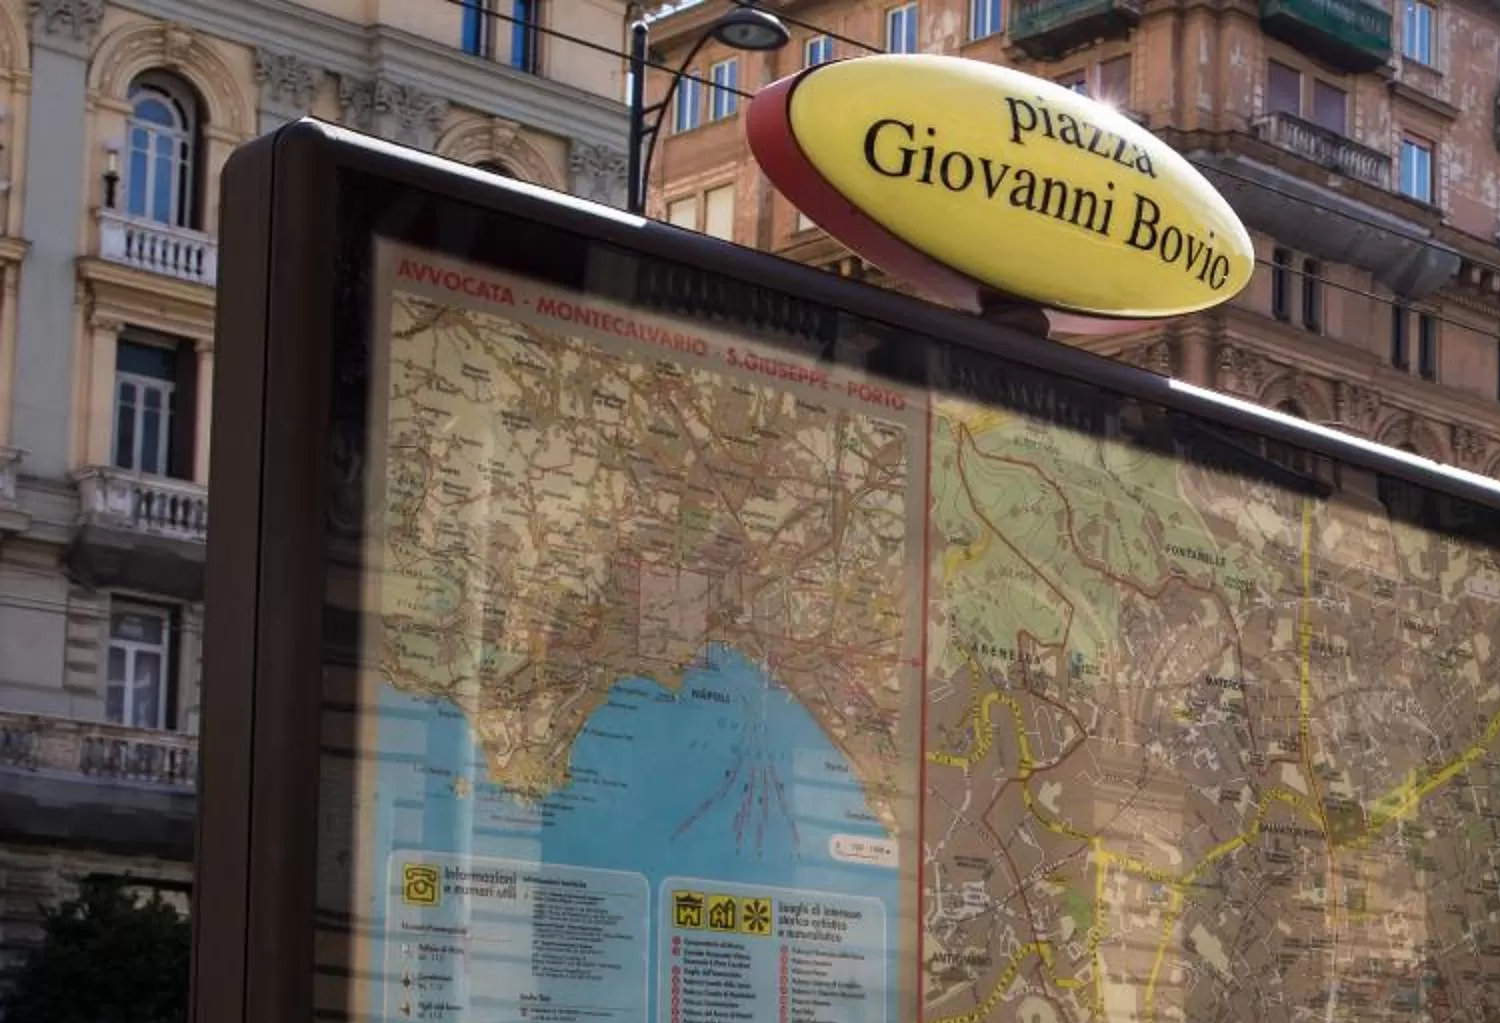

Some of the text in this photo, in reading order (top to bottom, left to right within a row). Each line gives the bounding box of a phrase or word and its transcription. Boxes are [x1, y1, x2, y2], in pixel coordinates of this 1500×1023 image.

[863, 118, 1231, 292] Giovanni Bovio
[1004, 96, 1157, 179] piazza
[396, 258, 516, 307] AVVOCATA
[535, 296, 709, 357] MONTECALVARIO
[848, 380, 907, 411] PORTO
